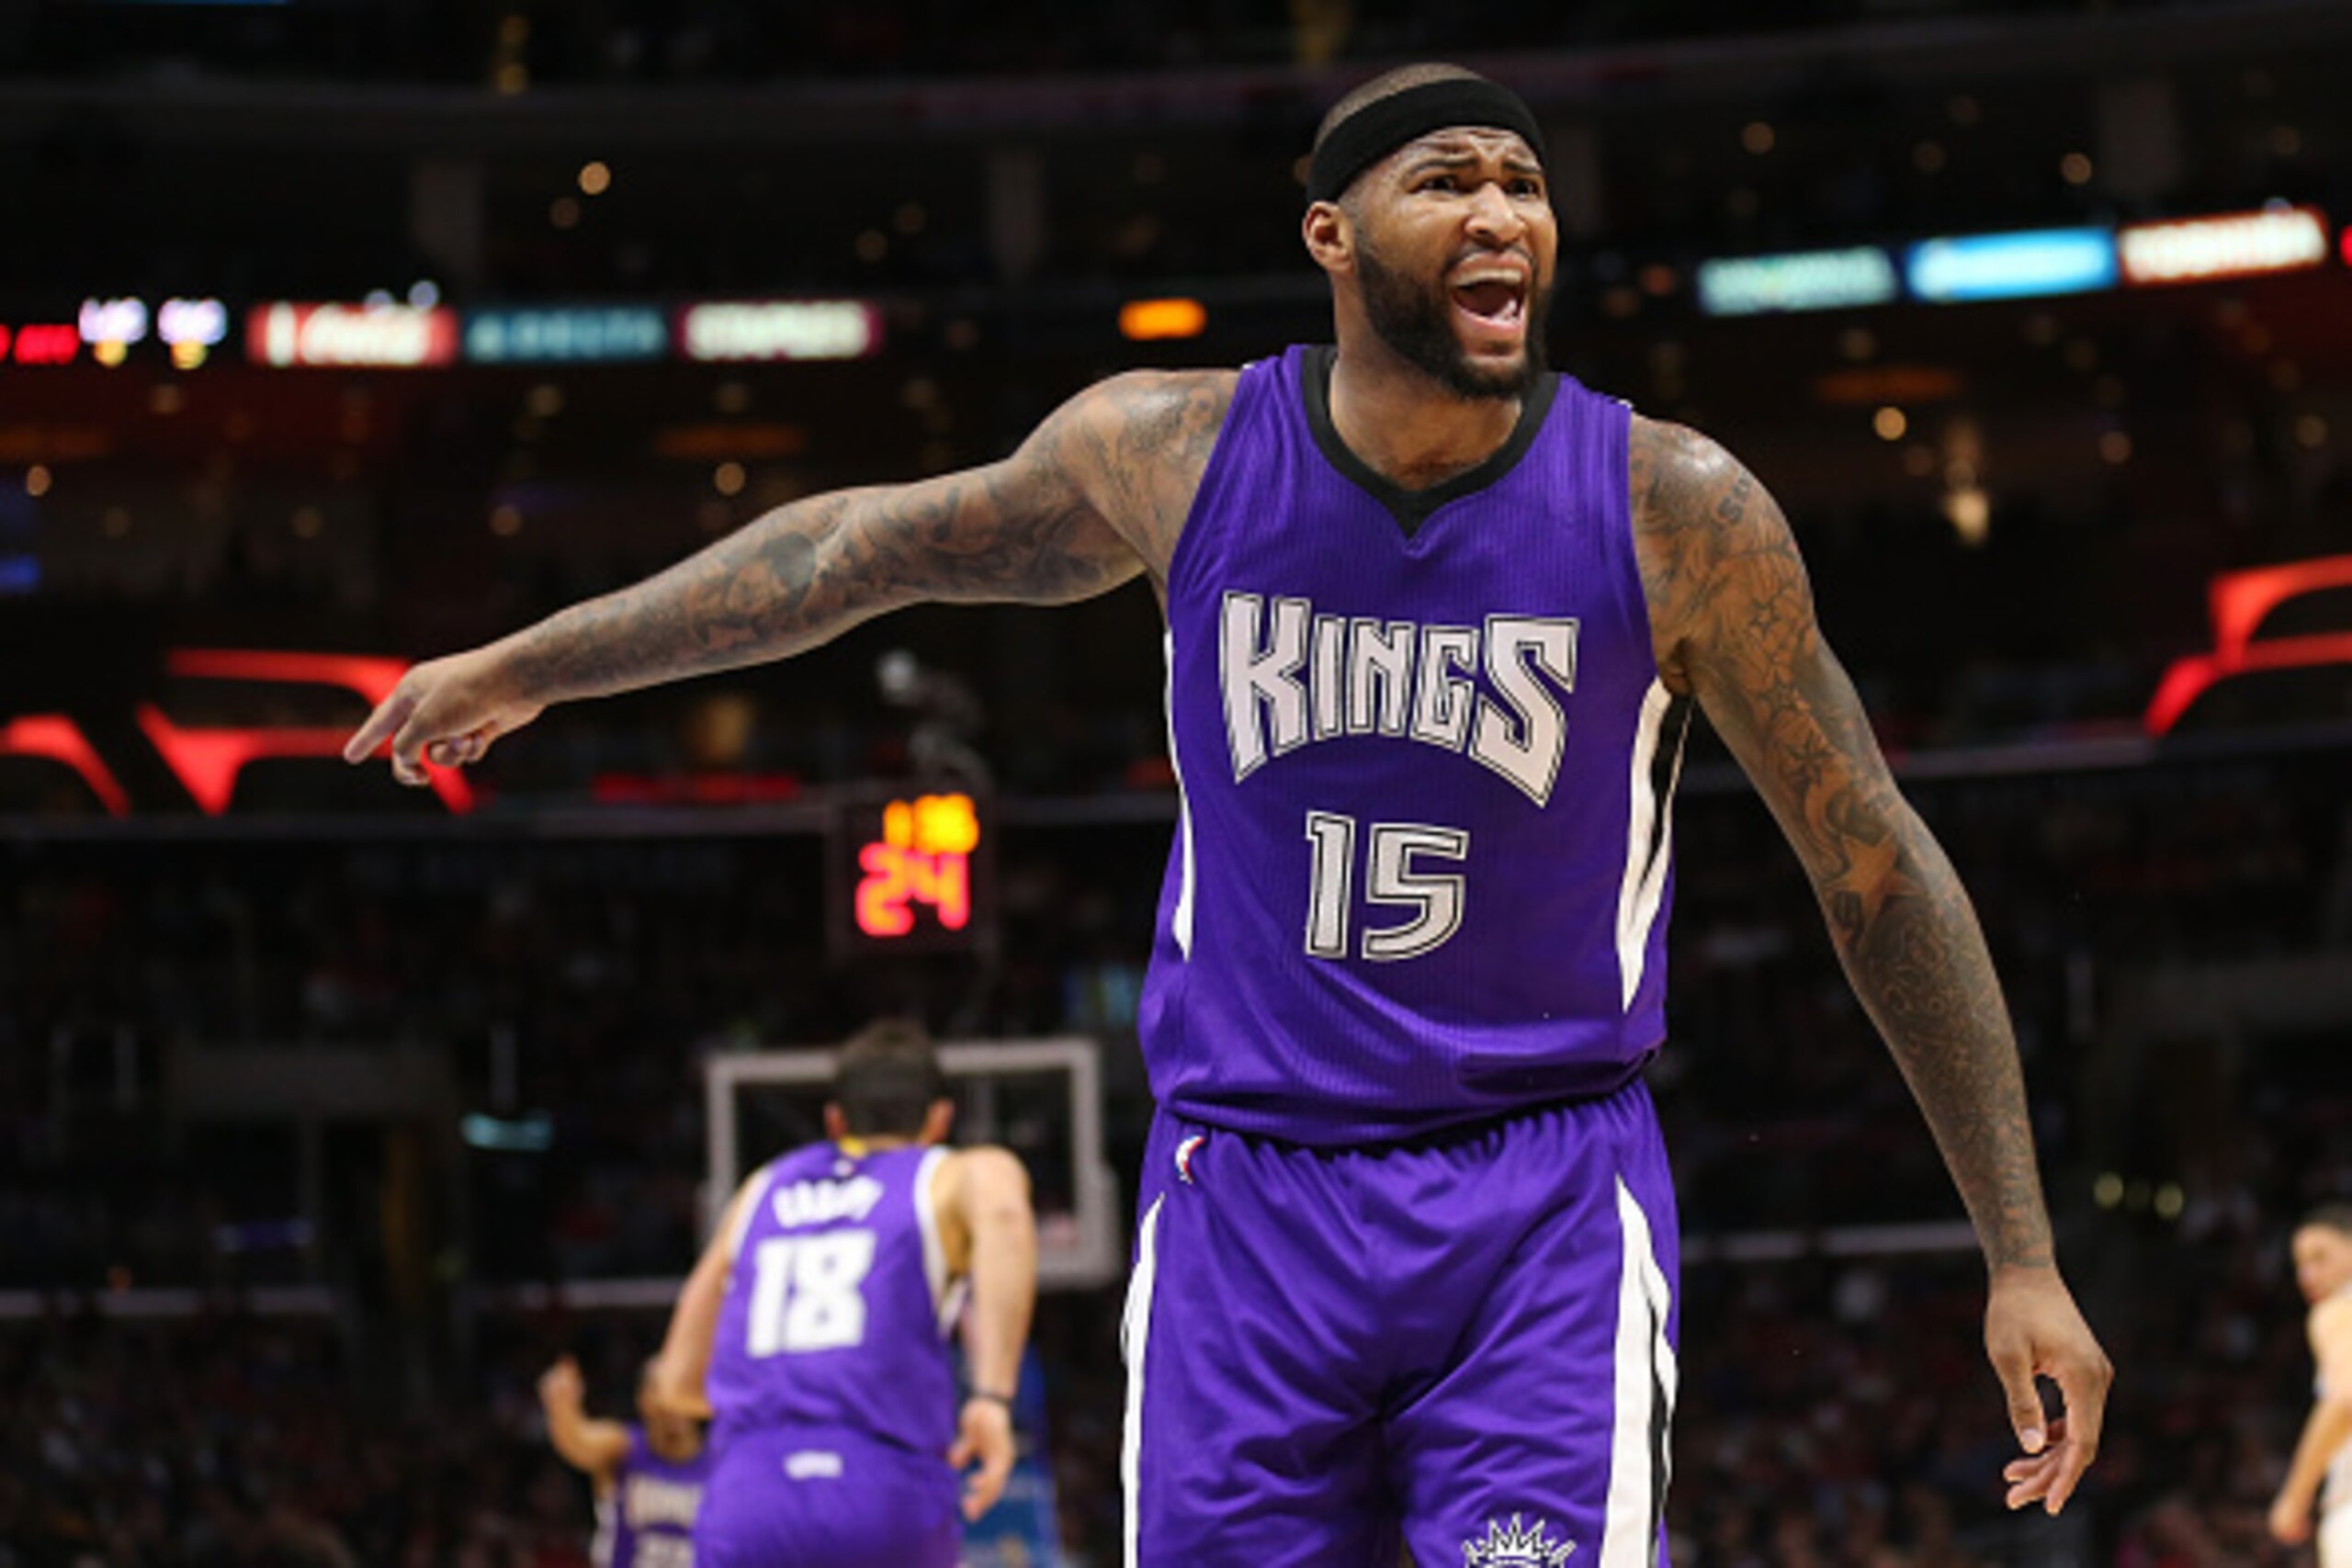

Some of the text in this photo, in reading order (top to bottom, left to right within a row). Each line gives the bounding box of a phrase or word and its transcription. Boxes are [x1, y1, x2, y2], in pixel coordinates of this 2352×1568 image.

[1217, 590, 1579, 809] KINGS
[855, 840, 971, 937] 24
[1305, 810, 1469, 962] 15
[746, 1228, 876, 1358] 18
